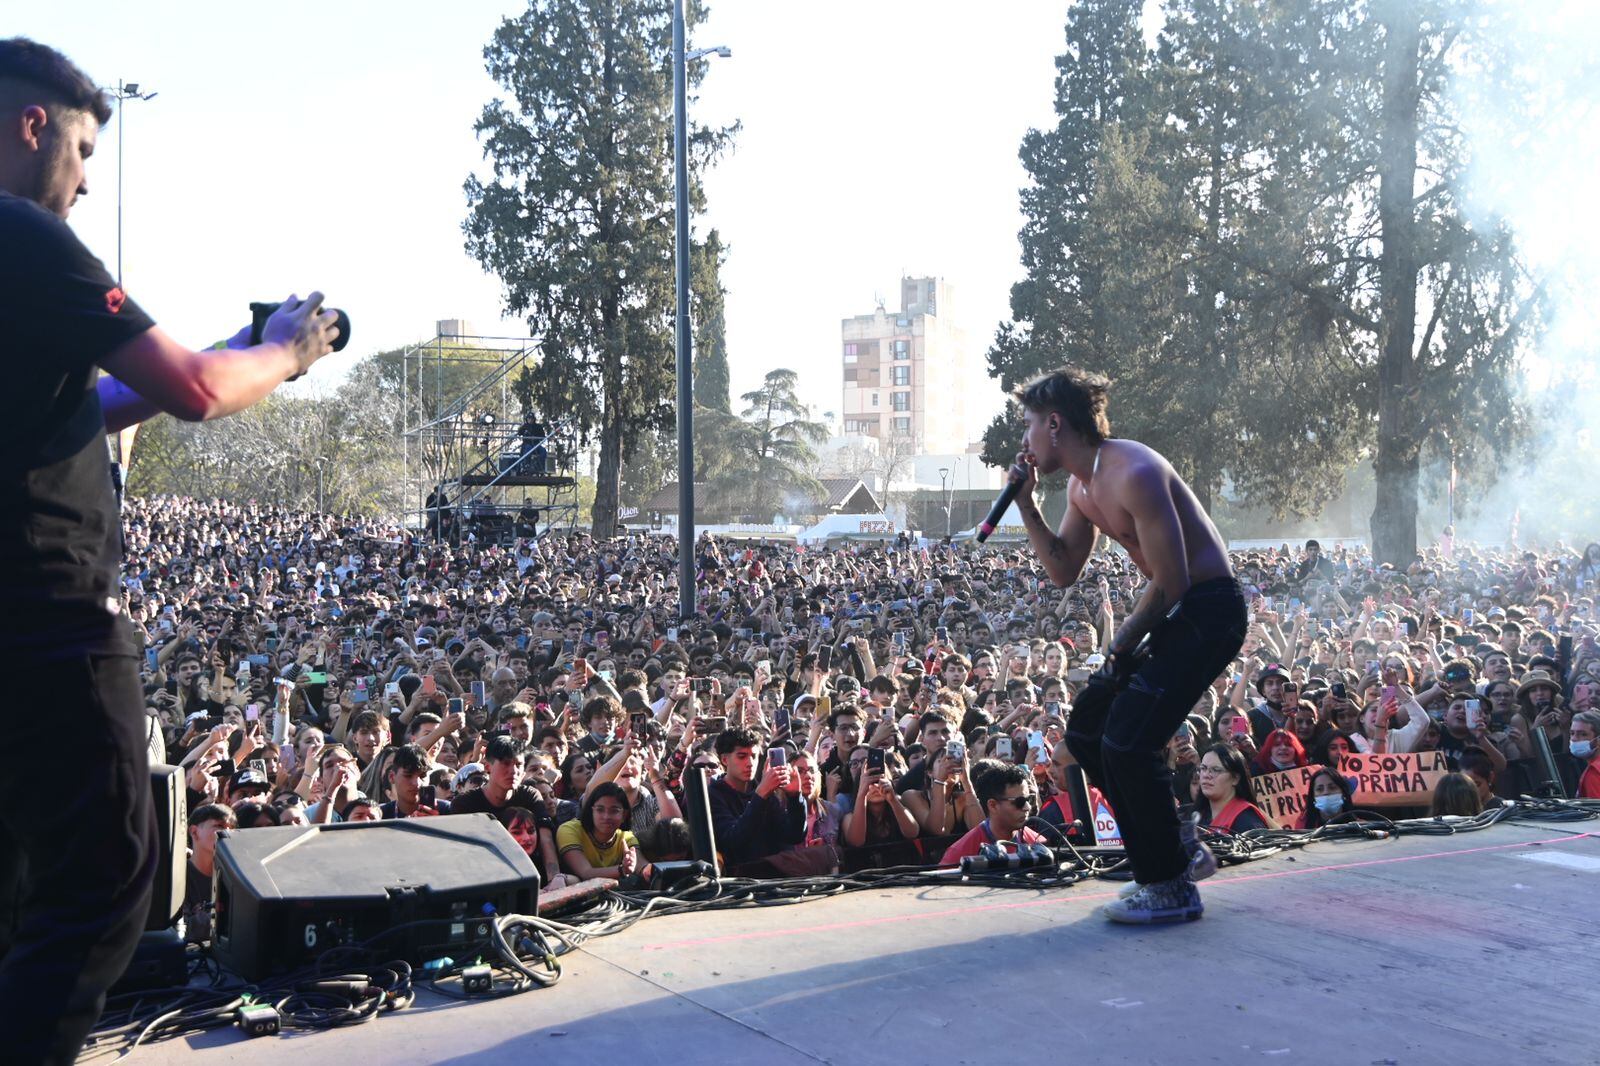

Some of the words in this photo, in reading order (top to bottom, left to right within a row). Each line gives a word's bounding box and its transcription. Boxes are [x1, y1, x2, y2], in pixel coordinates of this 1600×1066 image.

[1339, 755, 1363, 772] YO
[1369, 755, 1411, 773] SOY
[1416, 752, 1447, 771] LA
[1096, 820, 1114, 831] DC
[304, 924, 317, 947] 6
